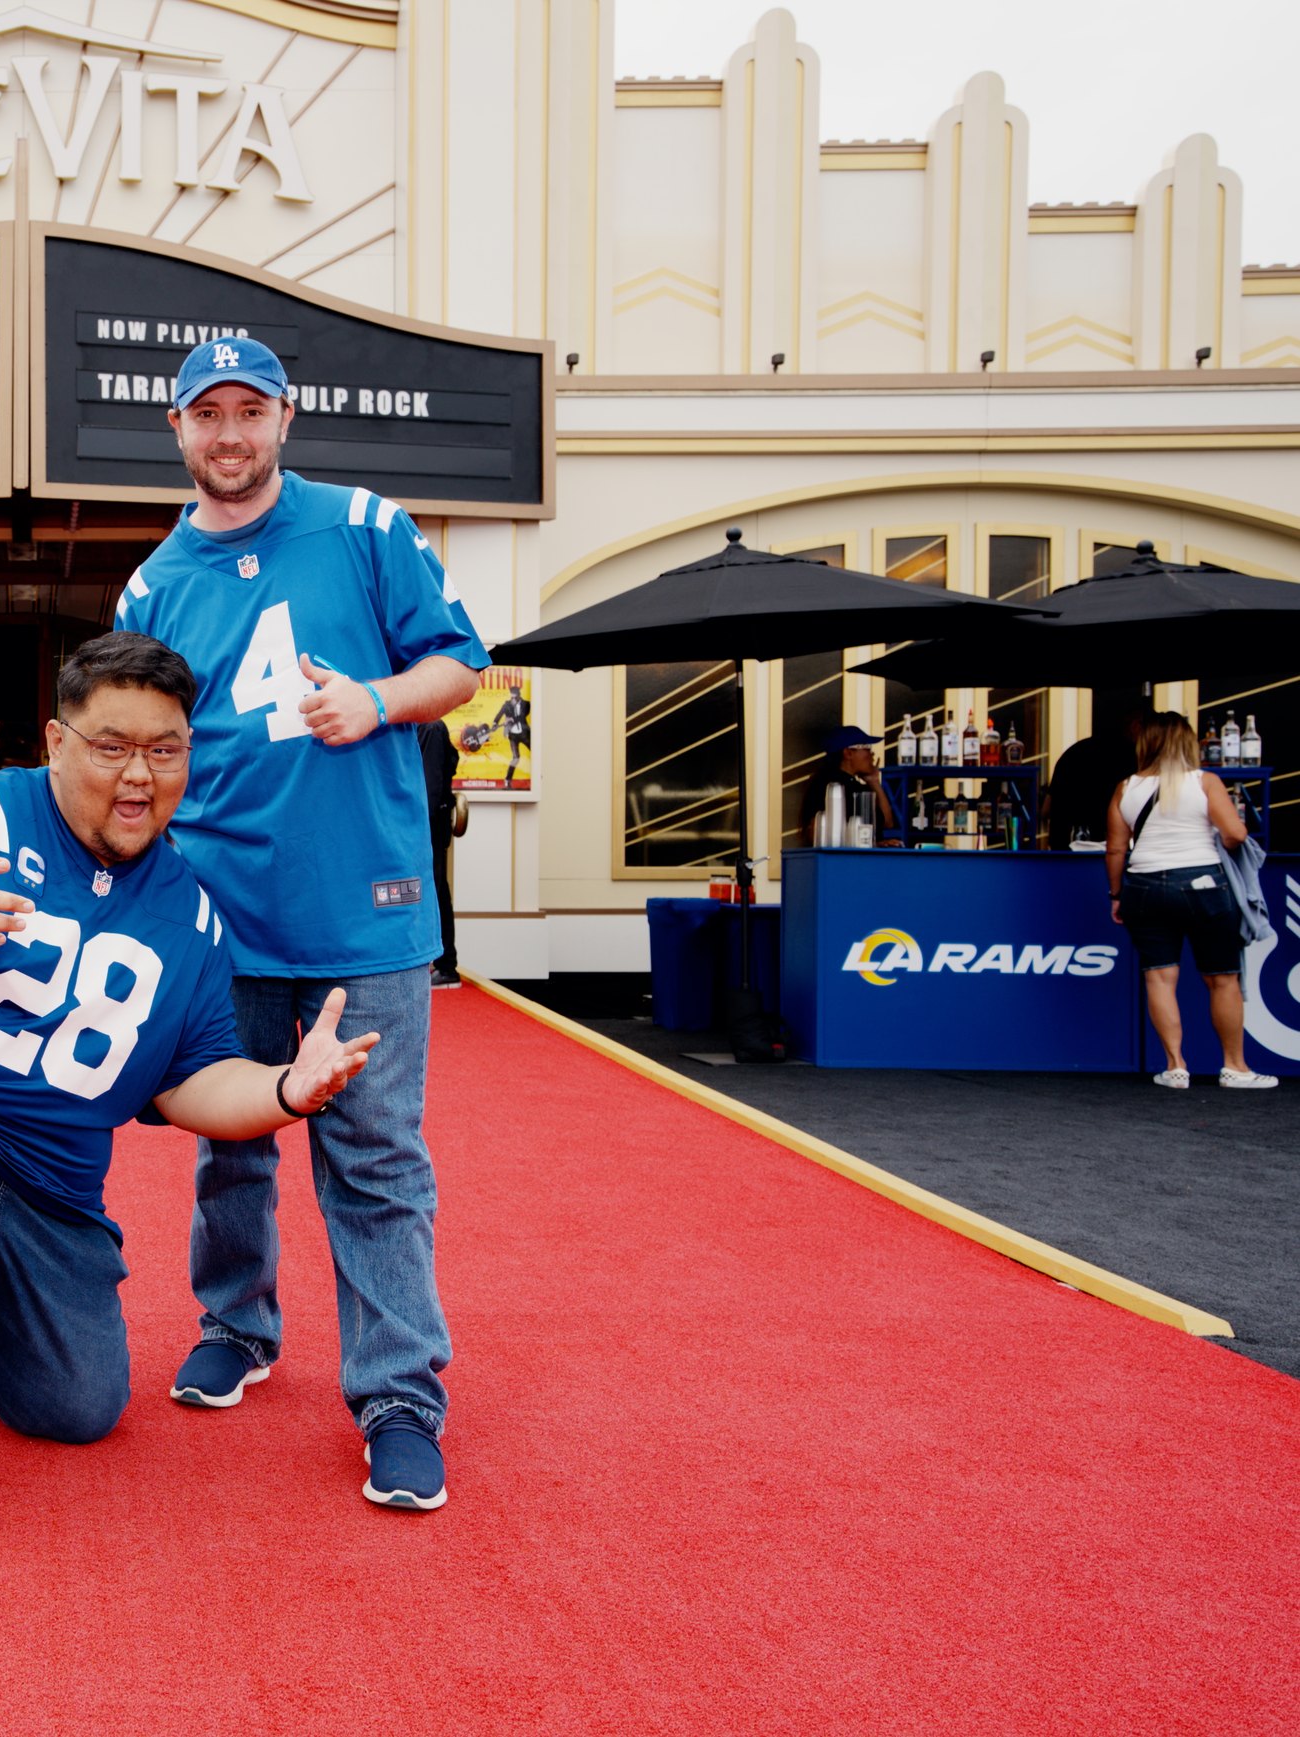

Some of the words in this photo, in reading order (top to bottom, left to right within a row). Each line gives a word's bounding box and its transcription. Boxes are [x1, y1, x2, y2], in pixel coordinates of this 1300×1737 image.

[97, 318, 147, 342] NOW
[212, 343, 240, 369] LA
[358, 390, 431, 418] ROCK
[241, 564, 258, 576] NFL
[230, 600, 316, 743] 4
[16, 845, 46, 885] C
[928, 943, 1119, 977] RAMS
